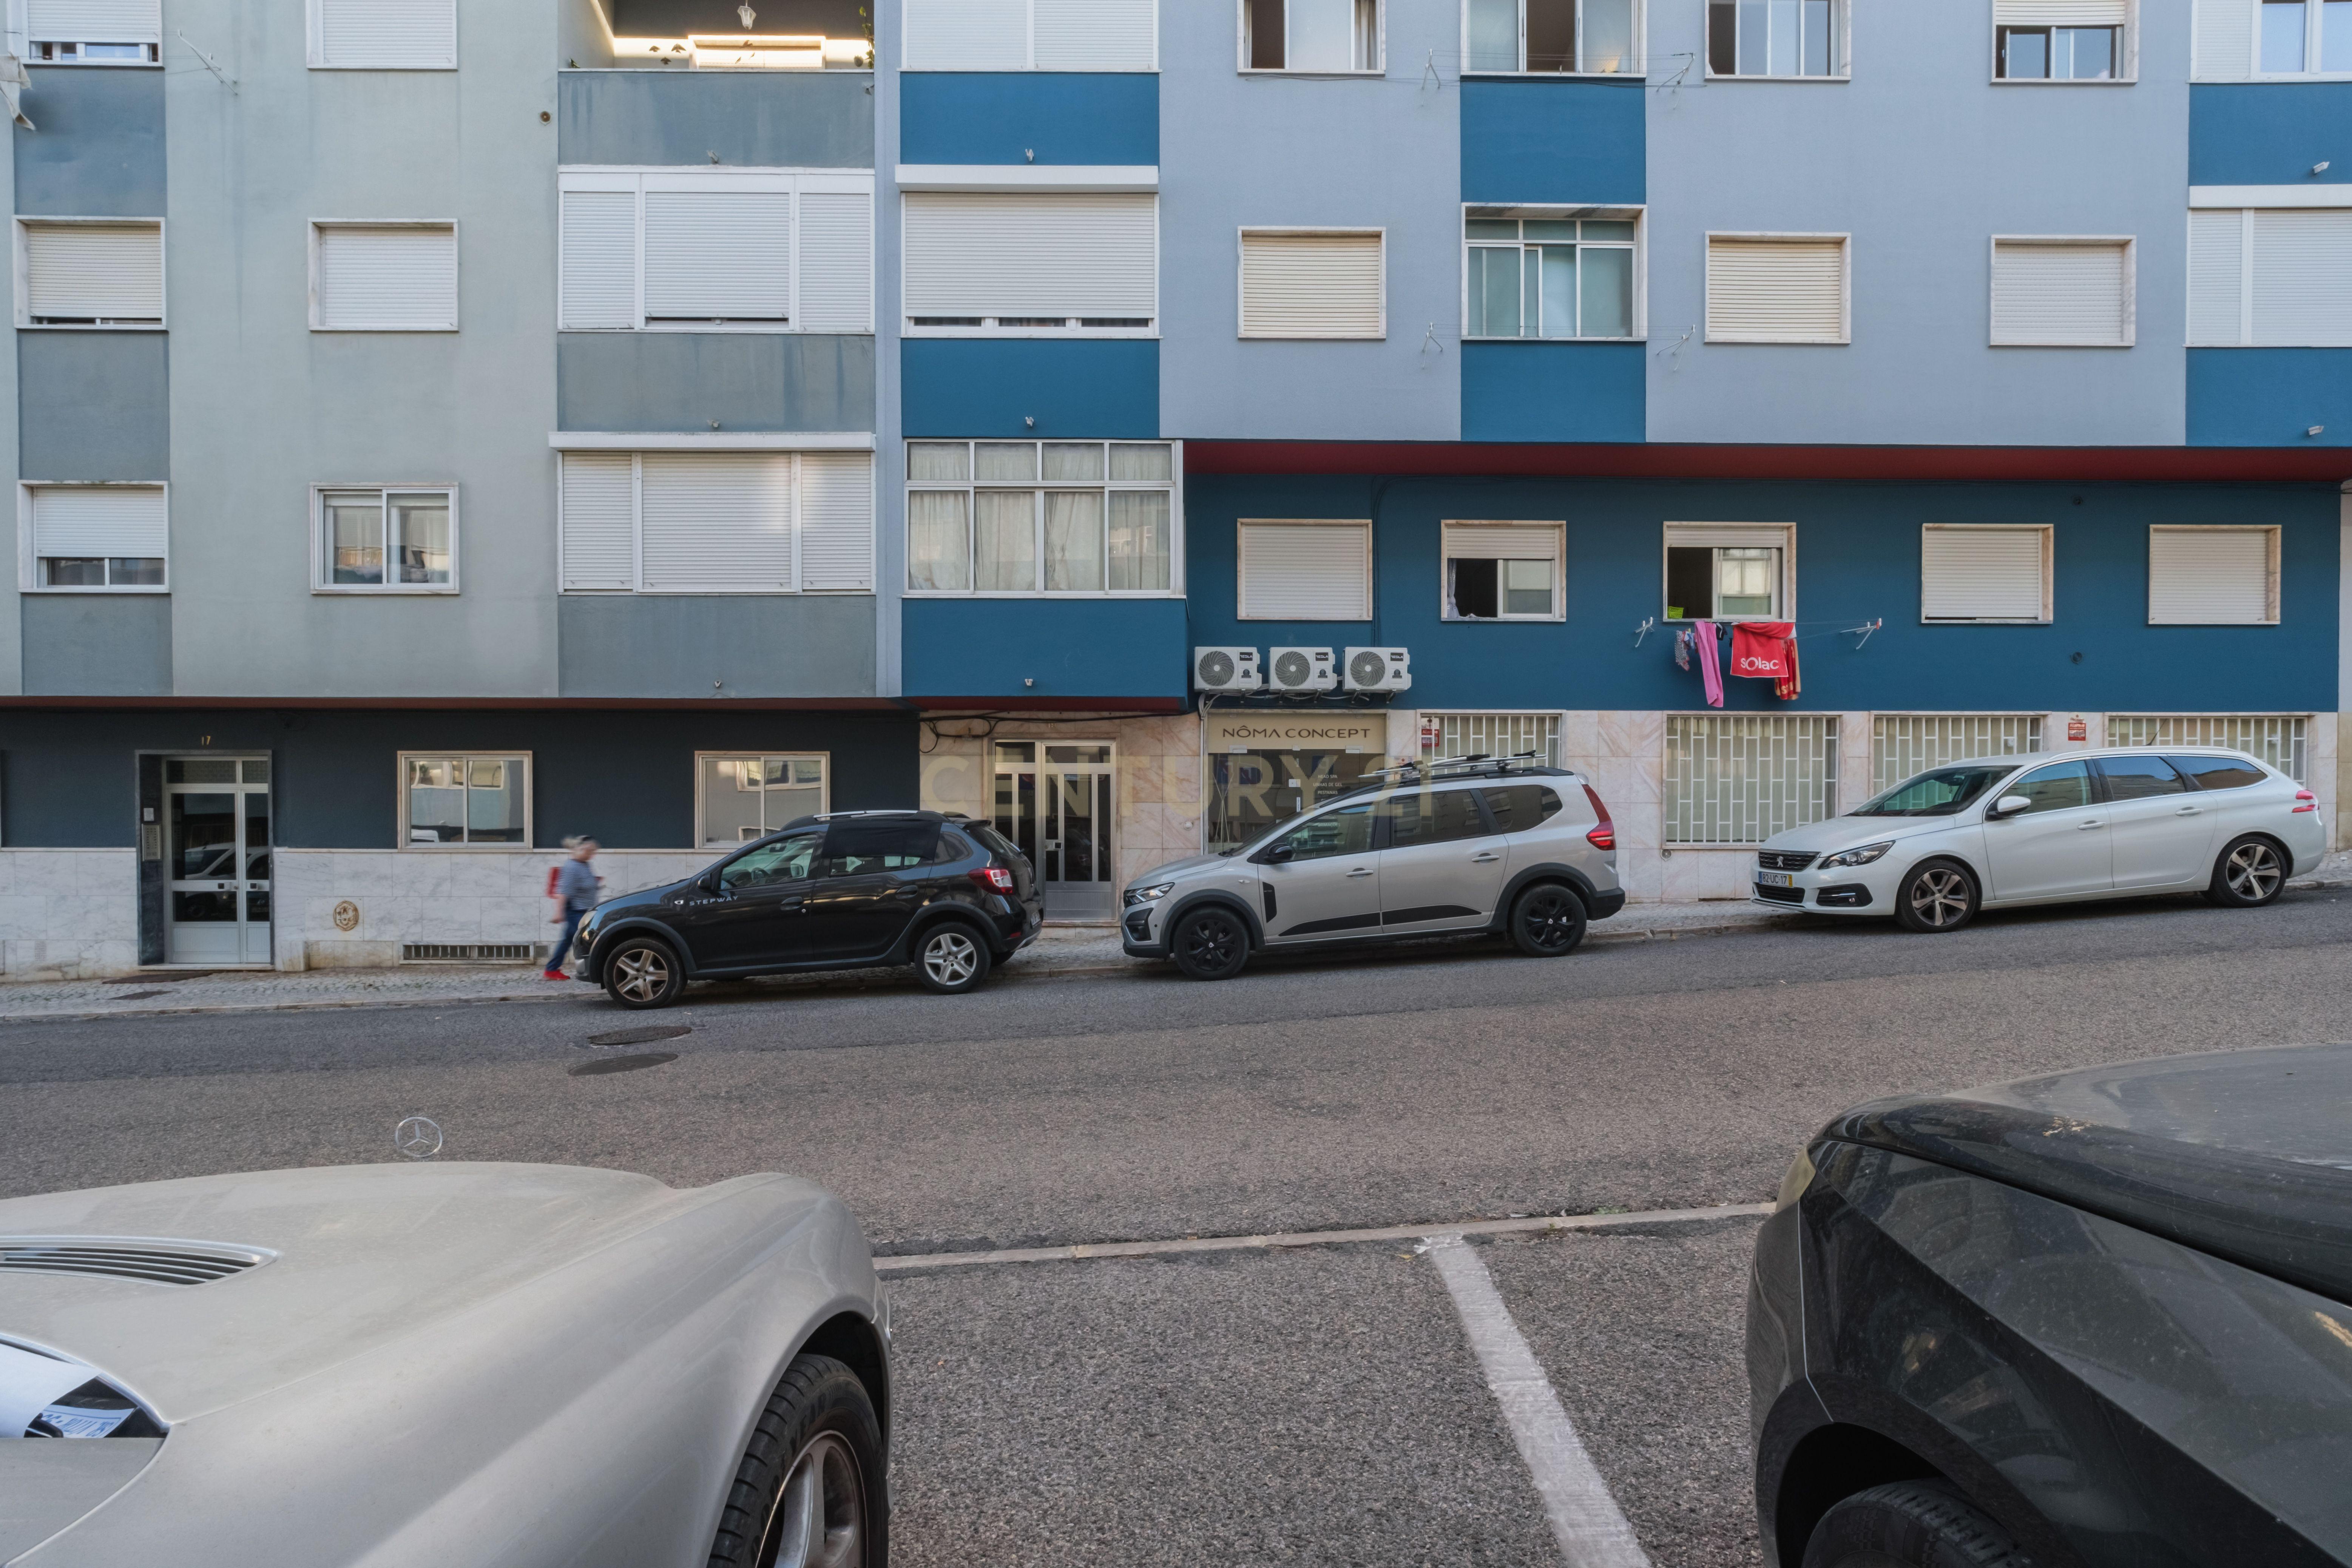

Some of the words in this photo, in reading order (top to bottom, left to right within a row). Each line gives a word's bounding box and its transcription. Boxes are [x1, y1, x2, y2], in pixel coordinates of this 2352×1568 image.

[1223, 725, 1281, 738] NÔMA
[1286, 728, 1370, 738] CONCEPT
[202, 736, 211, 745] 17
[689, 895, 738, 906] STEPWAY
